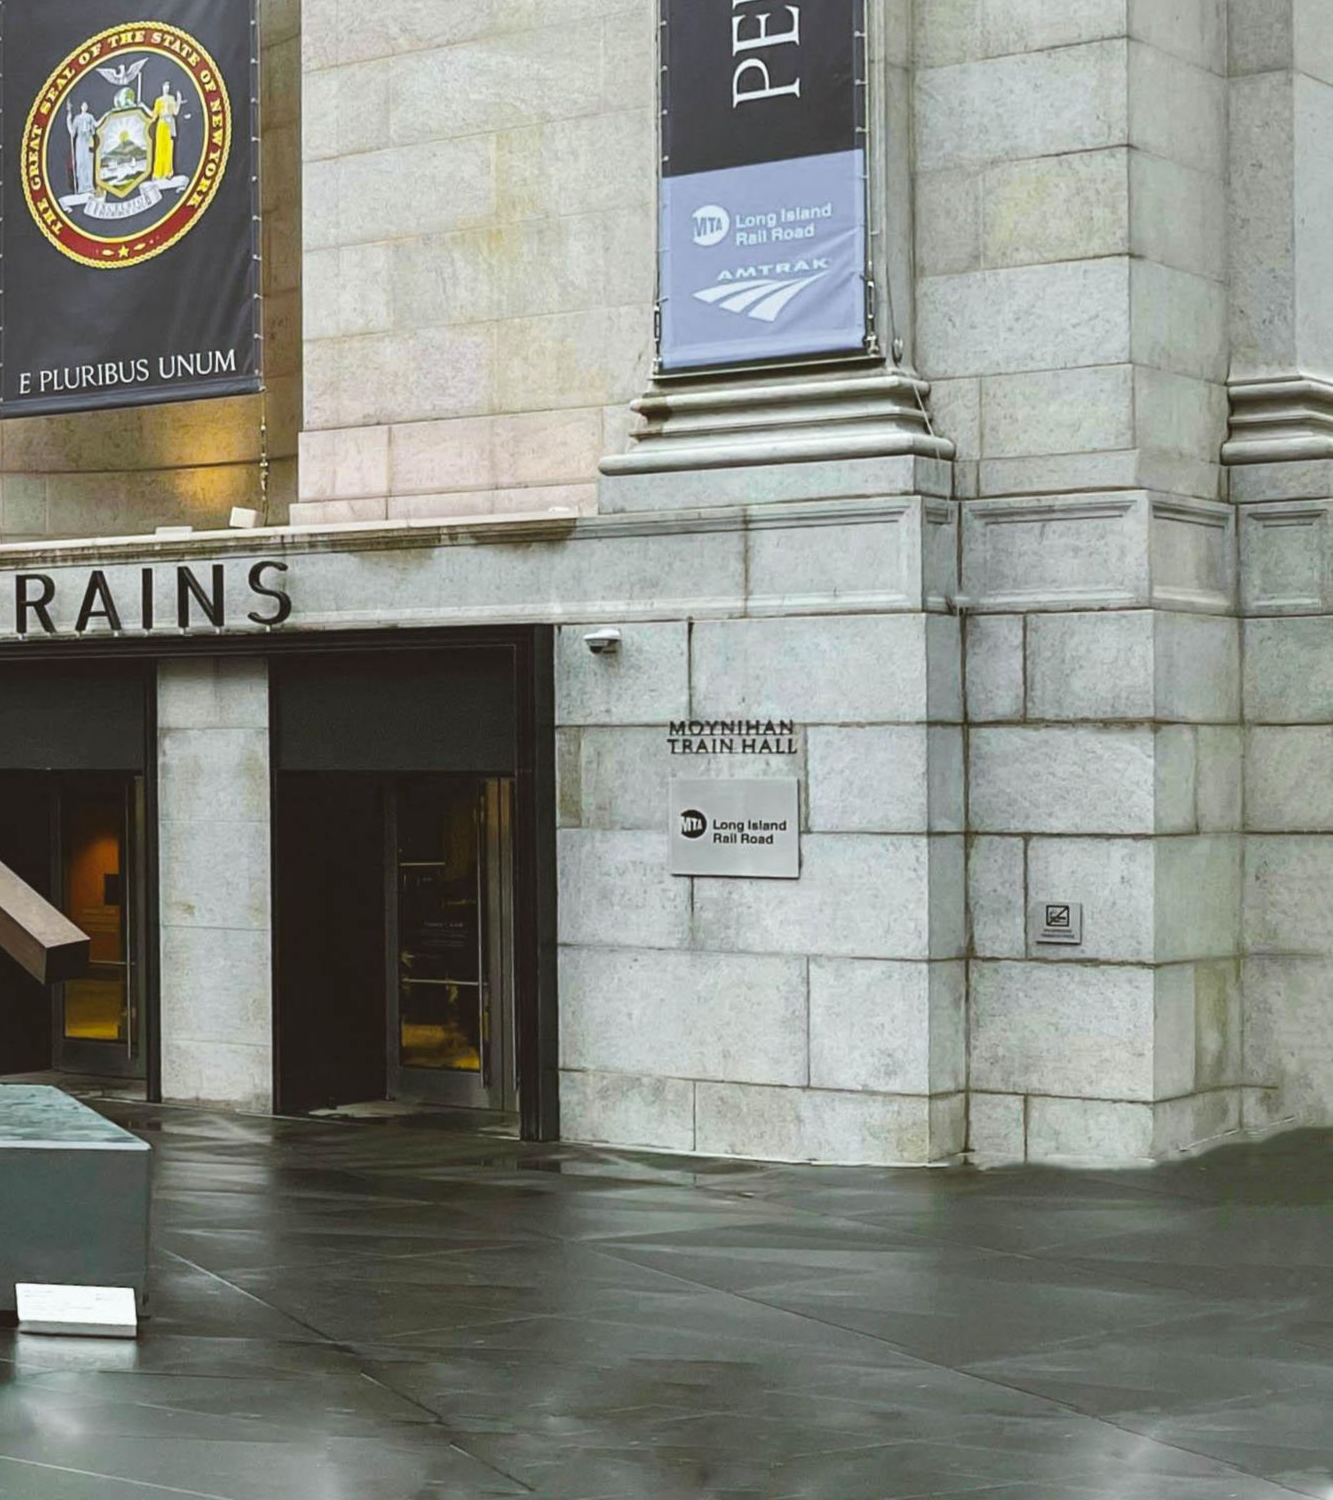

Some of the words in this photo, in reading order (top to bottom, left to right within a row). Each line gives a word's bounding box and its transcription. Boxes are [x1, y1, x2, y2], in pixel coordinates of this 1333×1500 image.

[107, 30, 146, 48] THE
[150, 31, 202, 67] STATE
[77, 43, 102, 65] OF
[39, 68, 76, 115] SEAL
[199, 69, 217, 93] OF
[209, 98, 224, 147] NEW
[28, 125, 43, 190] GREAT
[186, 147, 222, 209] YORK
[35, 198, 64, 236] THE
[735, 212, 777, 229] Long
[781, 203, 832, 222] Island
[735, 230, 767, 246] Rail
[771, 225, 815, 241] Road
[717, 258, 830, 281] AMTRAK
[19, 371, 31, 395] E
[39, 357, 150, 393] PLURIBUS
[158, 349, 237, 380] UNUM
[669, 719, 794, 736] MOYNIHAN
[667, 738, 733, 755] TRAIN
[742, 738, 798, 755] HALL
[712, 819, 744, 832] Long
[748, 819, 787, 831] Island
[712, 833, 737, 844] Rail
[741, 833, 774, 844] Road
